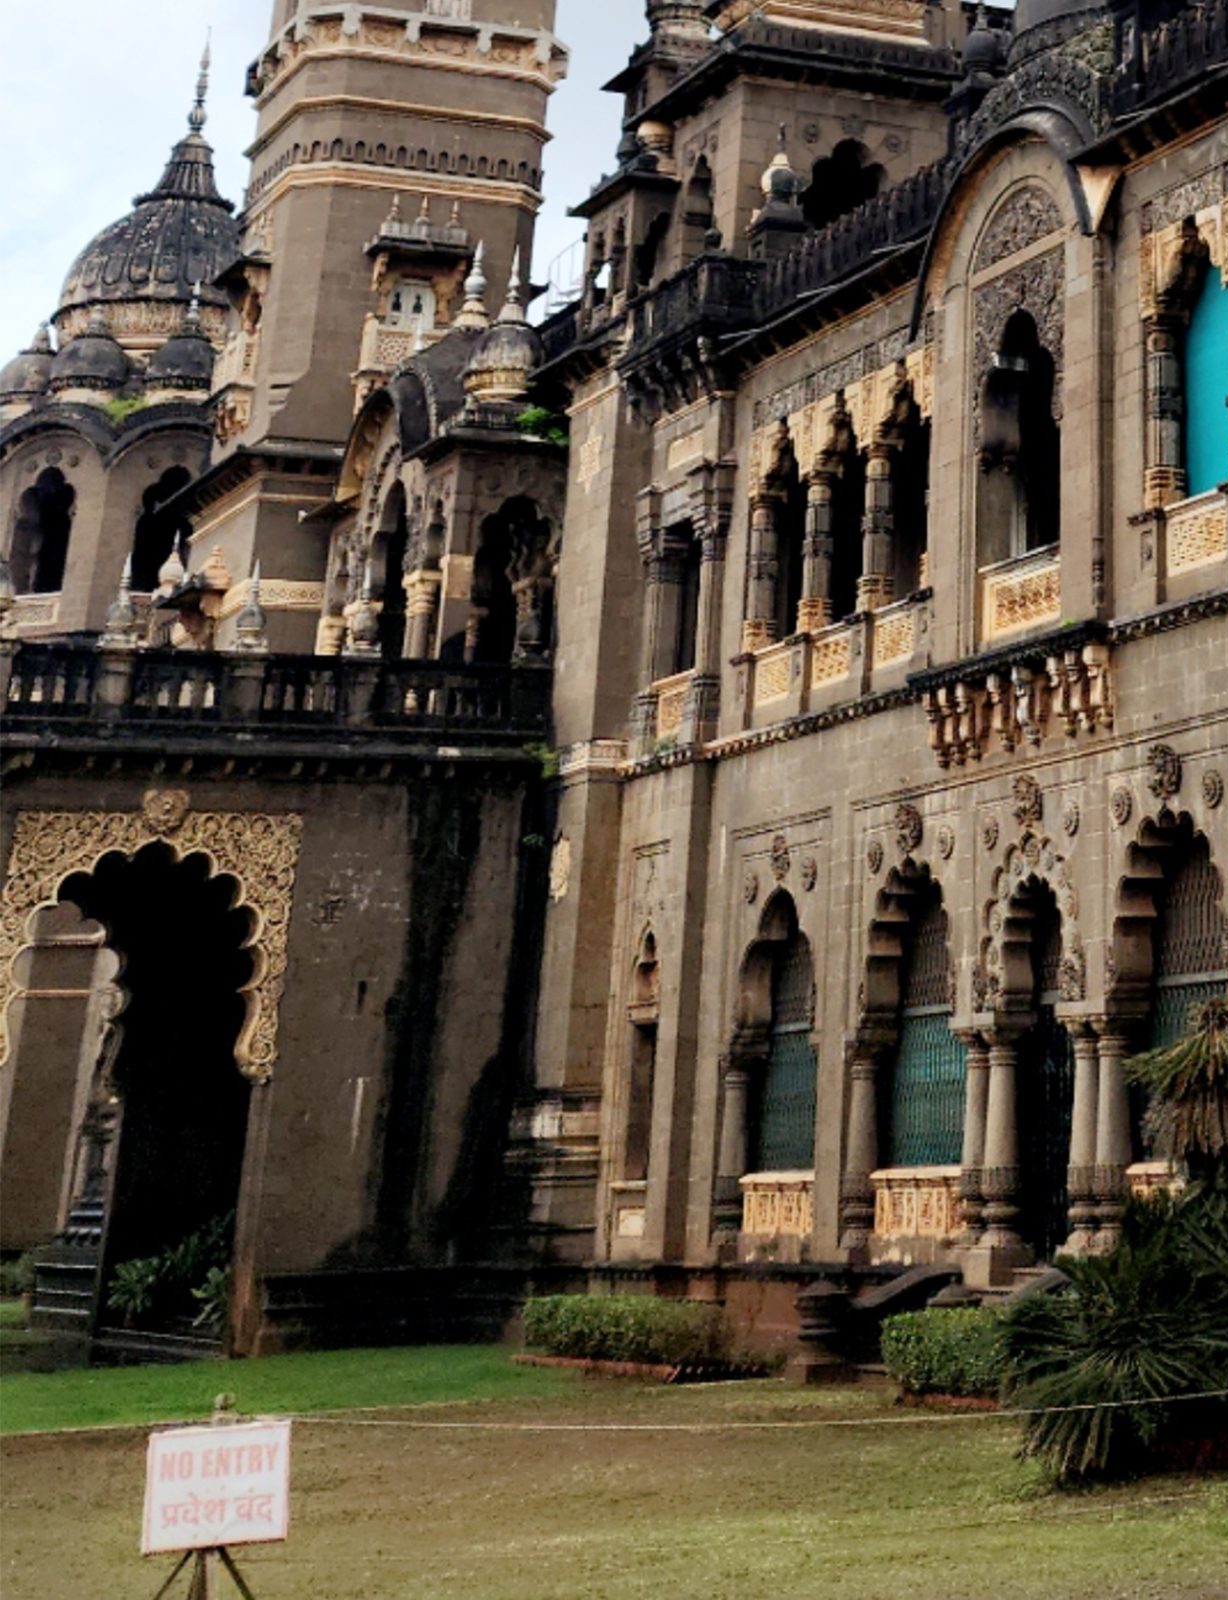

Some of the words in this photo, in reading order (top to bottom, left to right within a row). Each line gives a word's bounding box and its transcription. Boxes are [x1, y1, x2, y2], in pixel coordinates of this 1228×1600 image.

[160, 1451, 193, 1481] NO
[201, 1442, 279, 1478] ENTRY
[160, 1492, 229, 1529] प्रवेश
